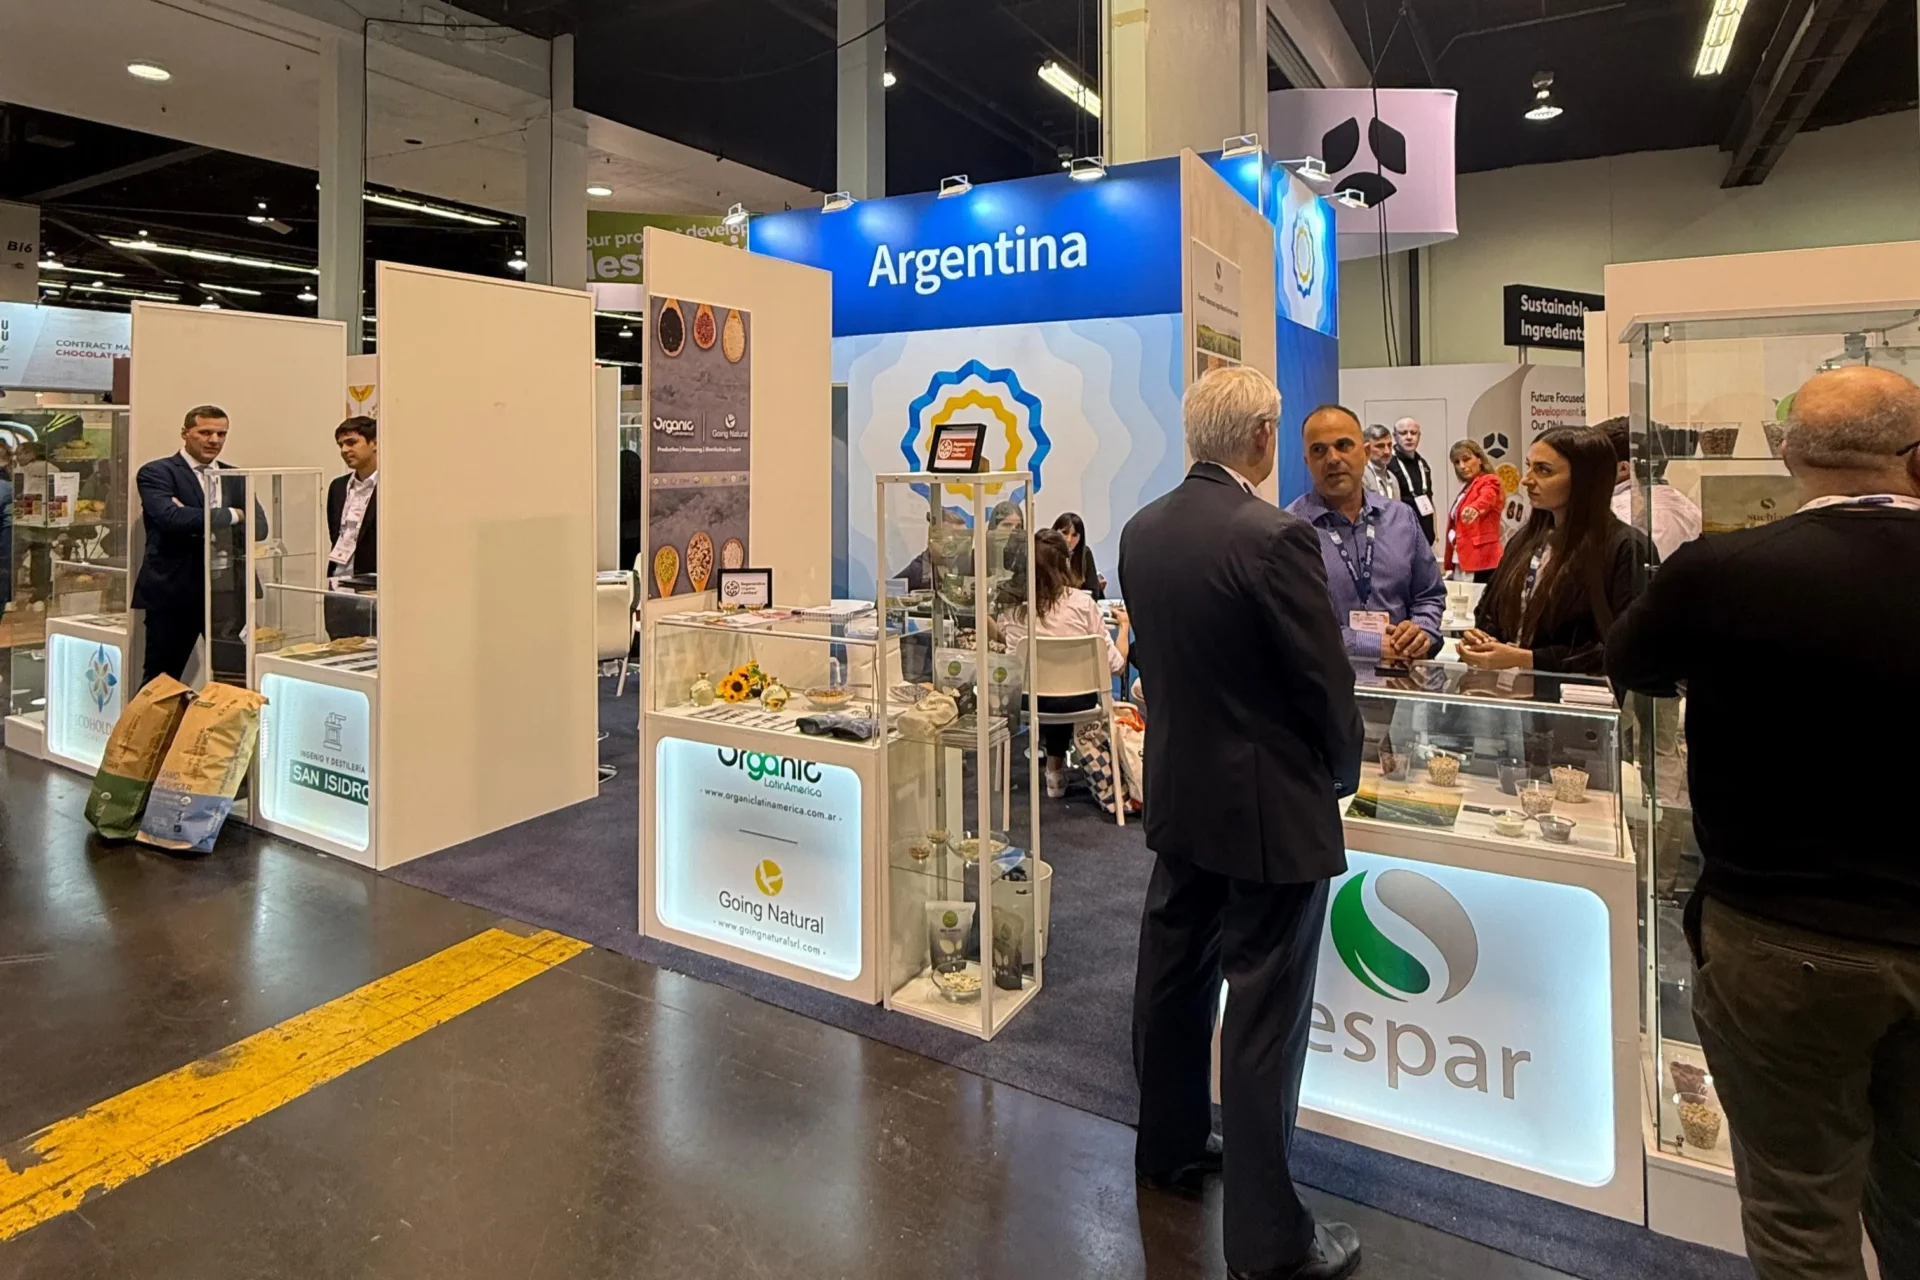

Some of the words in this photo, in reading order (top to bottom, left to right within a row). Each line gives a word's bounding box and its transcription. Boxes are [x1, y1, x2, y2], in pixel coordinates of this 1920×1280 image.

[868, 224, 1087, 295] Argentina
[56, 339, 112, 350] CONTRACT
[1531, 391, 1554, 402] Future
[1556, 392, 1585, 403] Focused
[1531, 405, 1580, 418] Development
[653, 417, 694, 434] Organic
[712, 429, 728, 439] Going
[729, 430, 748, 438] Natural
[1531, 419, 1546, 430] Our
[325, 756, 330, 764] Y
[717, 747, 822, 784] Organic
[293, 764, 320, 787] SAN
[764, 777, 822, 798] LatinAmerica
[704, 788, 836, 821] www.organiclatinamerica.com.ar
[719, 890, 763, 921] Going
[768, 902, 824, 934] Natural
[718, 920, 821, 955] www.goingnaturalsrl.com
